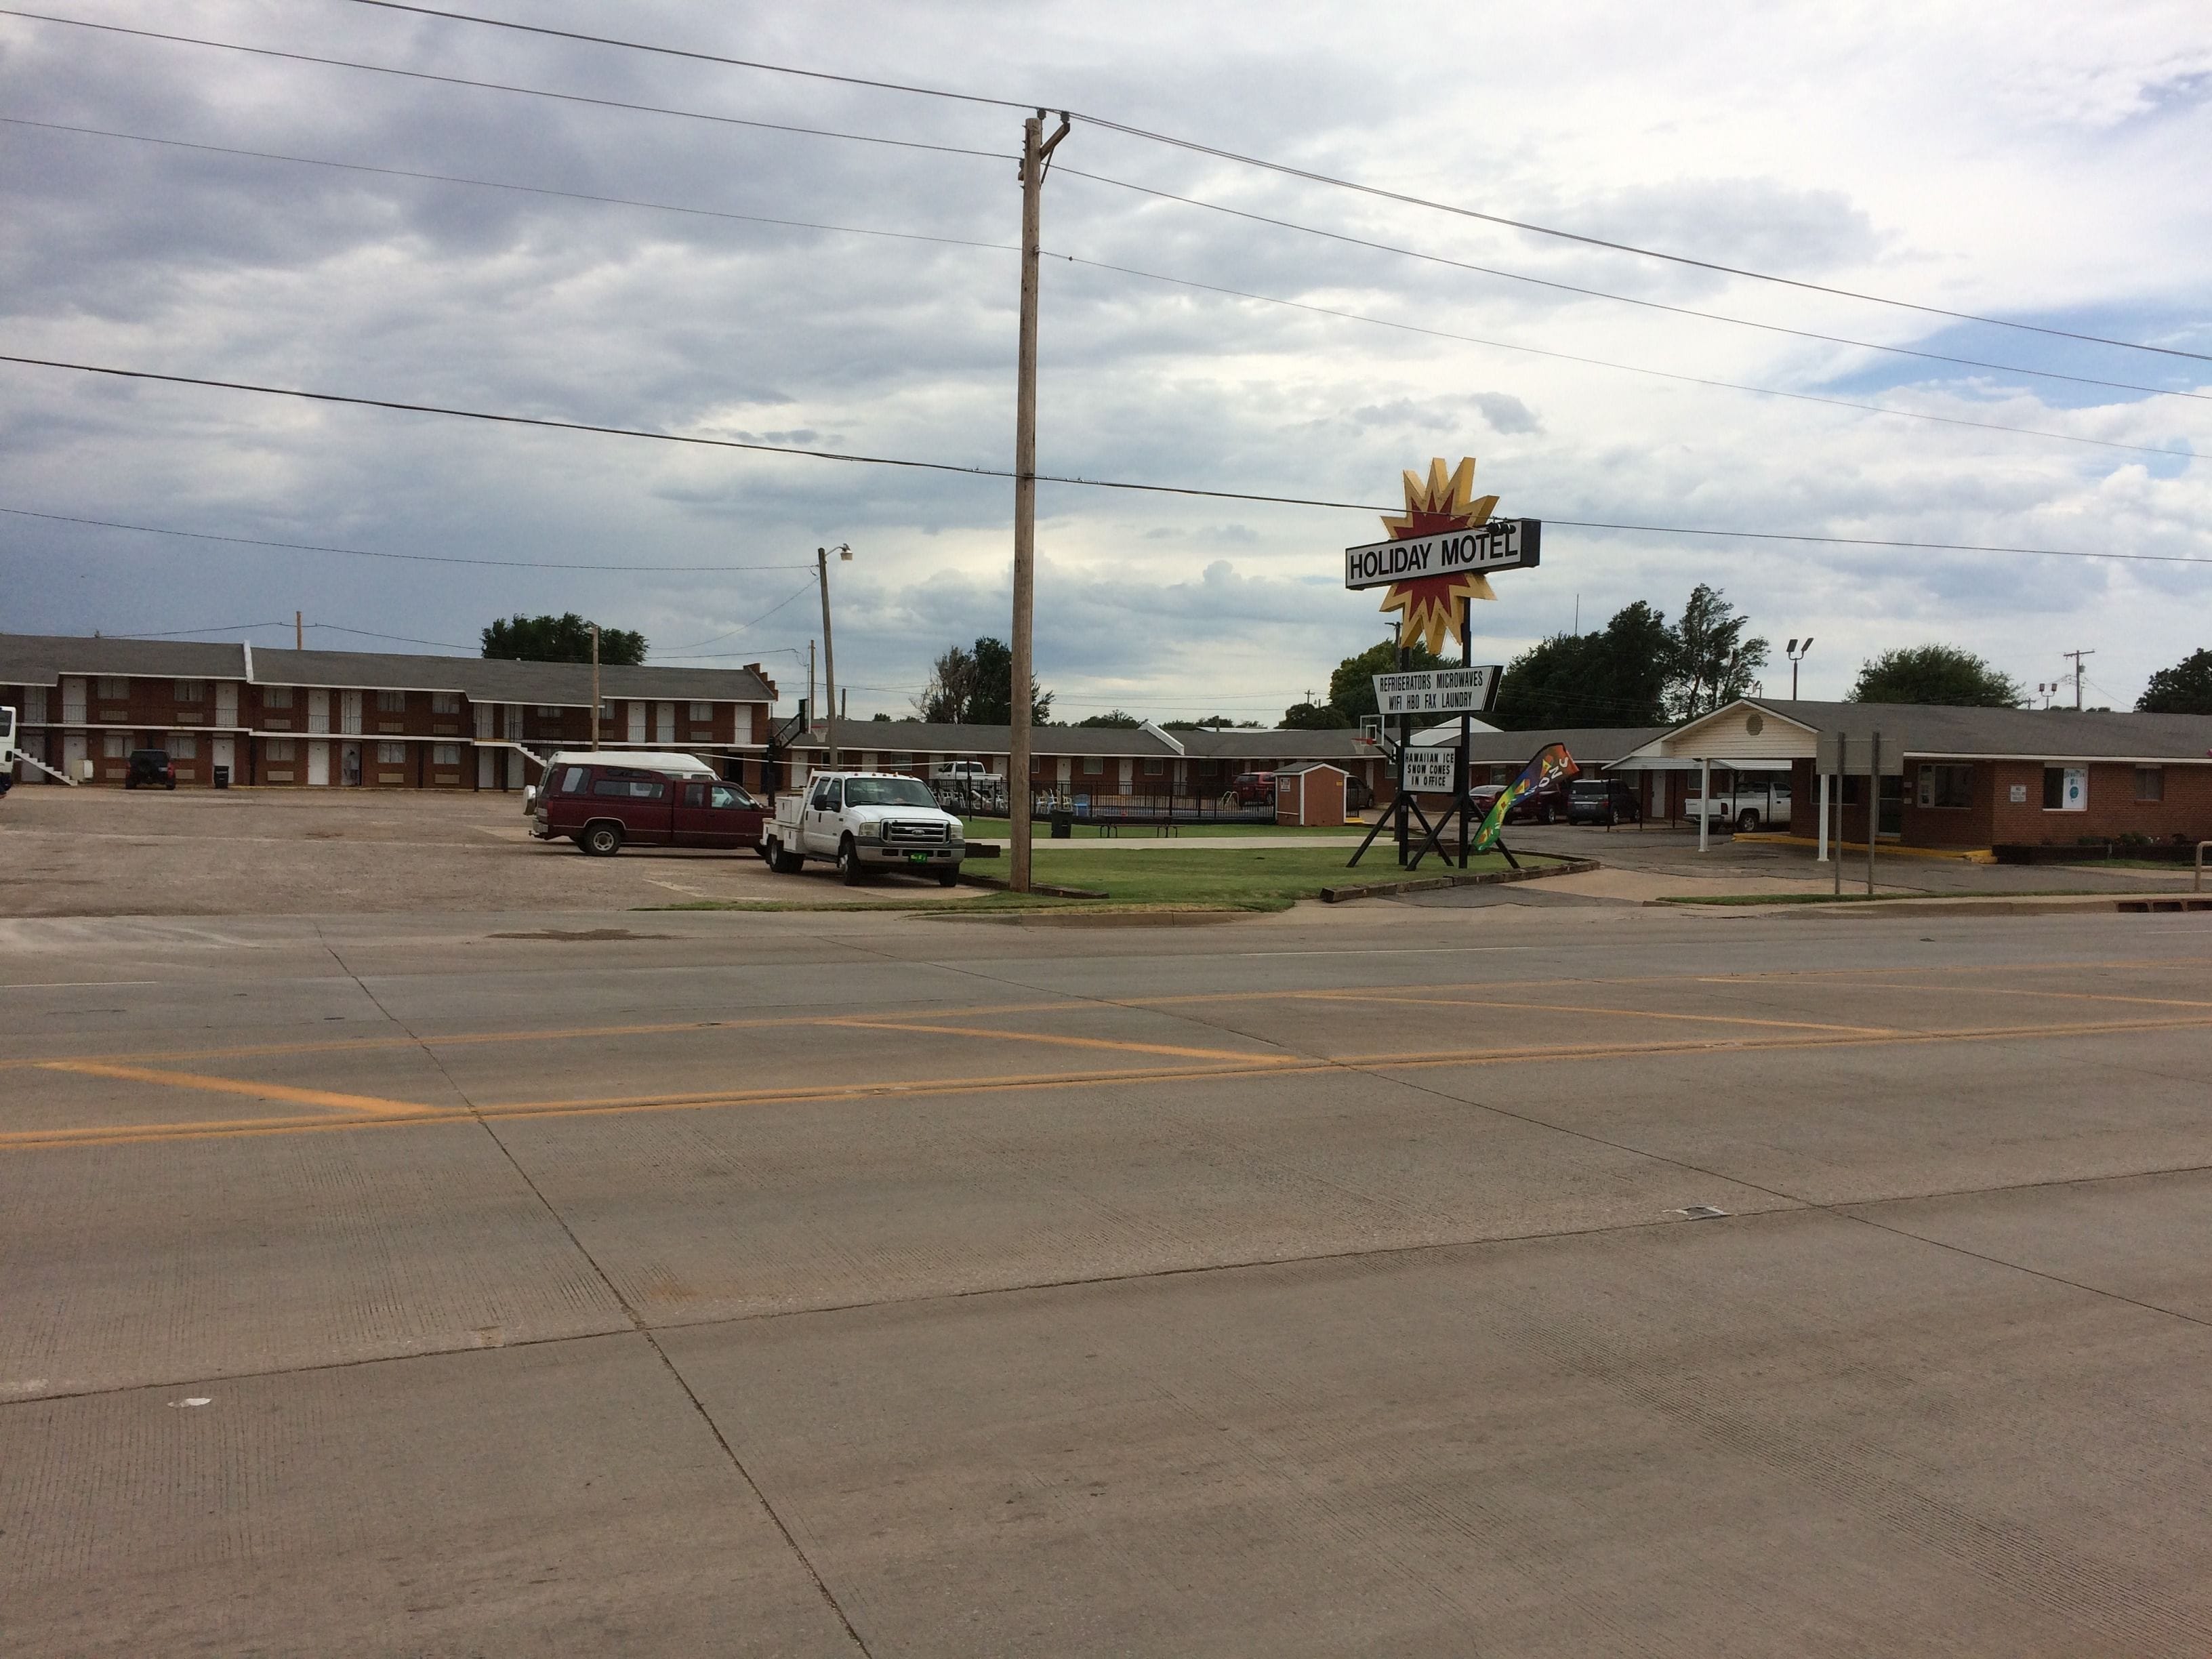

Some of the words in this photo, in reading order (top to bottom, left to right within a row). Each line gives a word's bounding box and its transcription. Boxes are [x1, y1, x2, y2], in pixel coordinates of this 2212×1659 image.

[1351, 543, 1432, 579] HOLIDAY
[1441, 533, 1517, 567] MOTEL
[1380, 674, 1431, 692] REFRIGERATORS
[1436, 671, 1483, 689] MICROWAVES
[1389, 695, 1401, 710] WIFI
[1407, 694, 1420, 710] HBO
[1425, 693, 1437, 709] FAX
[1442, 691, 1472, 708] LAUNDRY
[1406, 753, 1438, 763] HAWAIIAN
[1443, 753, 1454, 763] ICE
[1408, 764, 1426, 774] SNOW
[1430, 764, 1450, 775] CONES
[1412, 776, 1419, 785] IN
[1424, 776, 1446, 786] OFFICE
